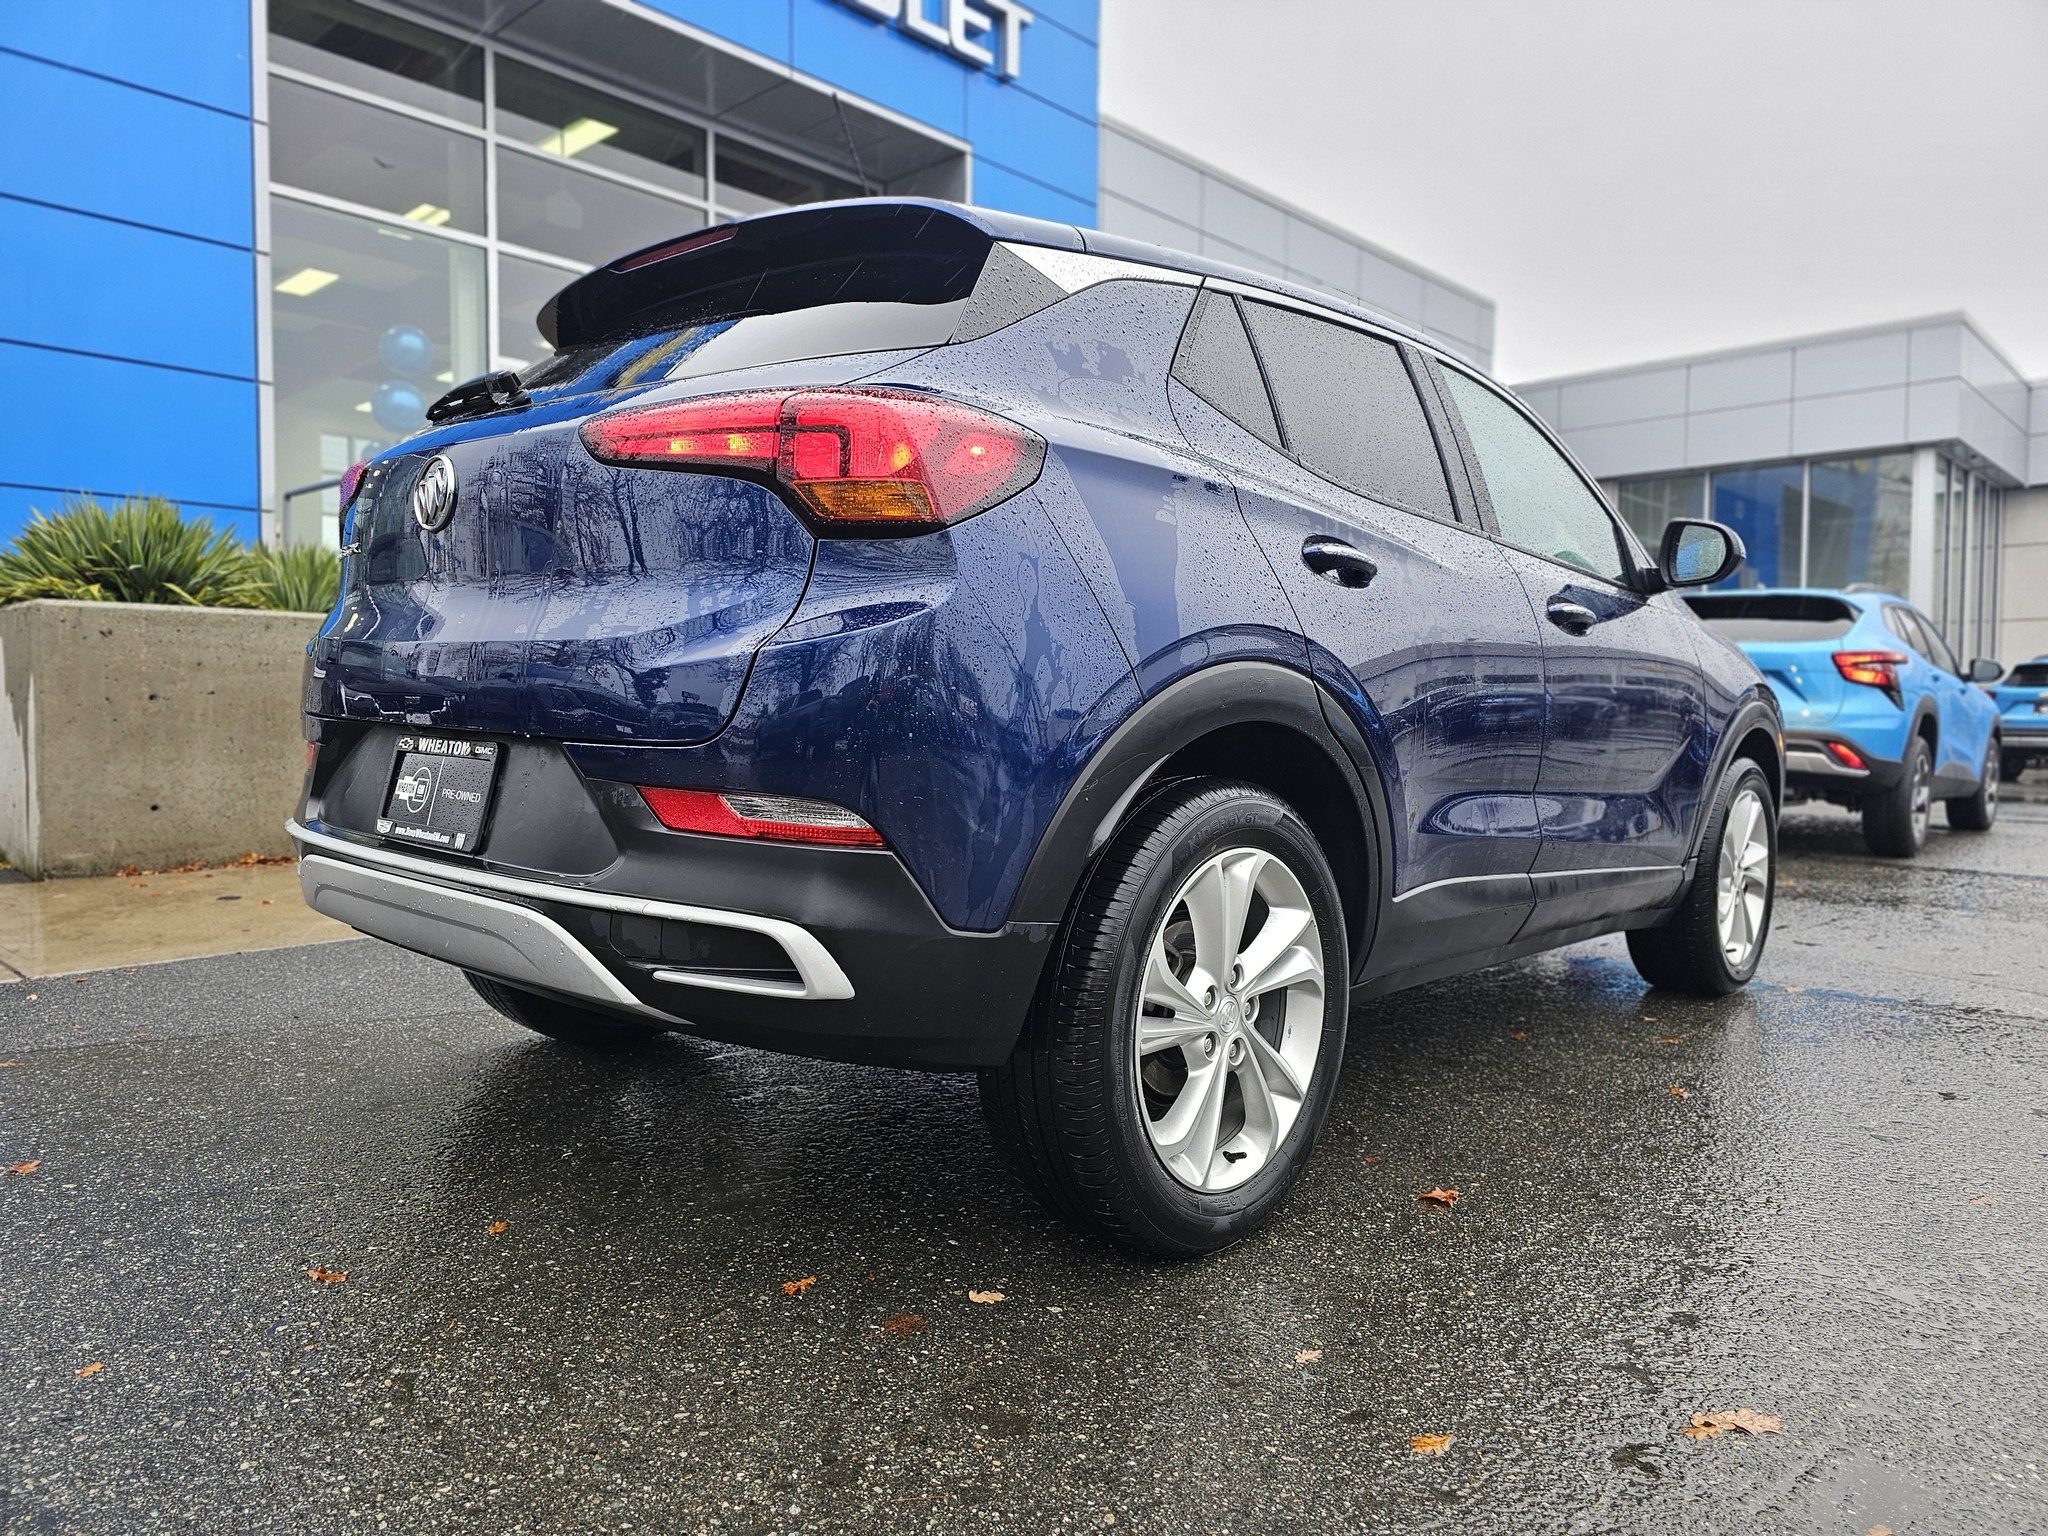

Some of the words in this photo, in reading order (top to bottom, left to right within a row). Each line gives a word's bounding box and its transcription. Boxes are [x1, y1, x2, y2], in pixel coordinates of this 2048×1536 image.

[418, 737, 470, 756] WHEATON
[475, 746, 494, 755] GMC
[441, 788, 480, 803] PRE-OWNED
